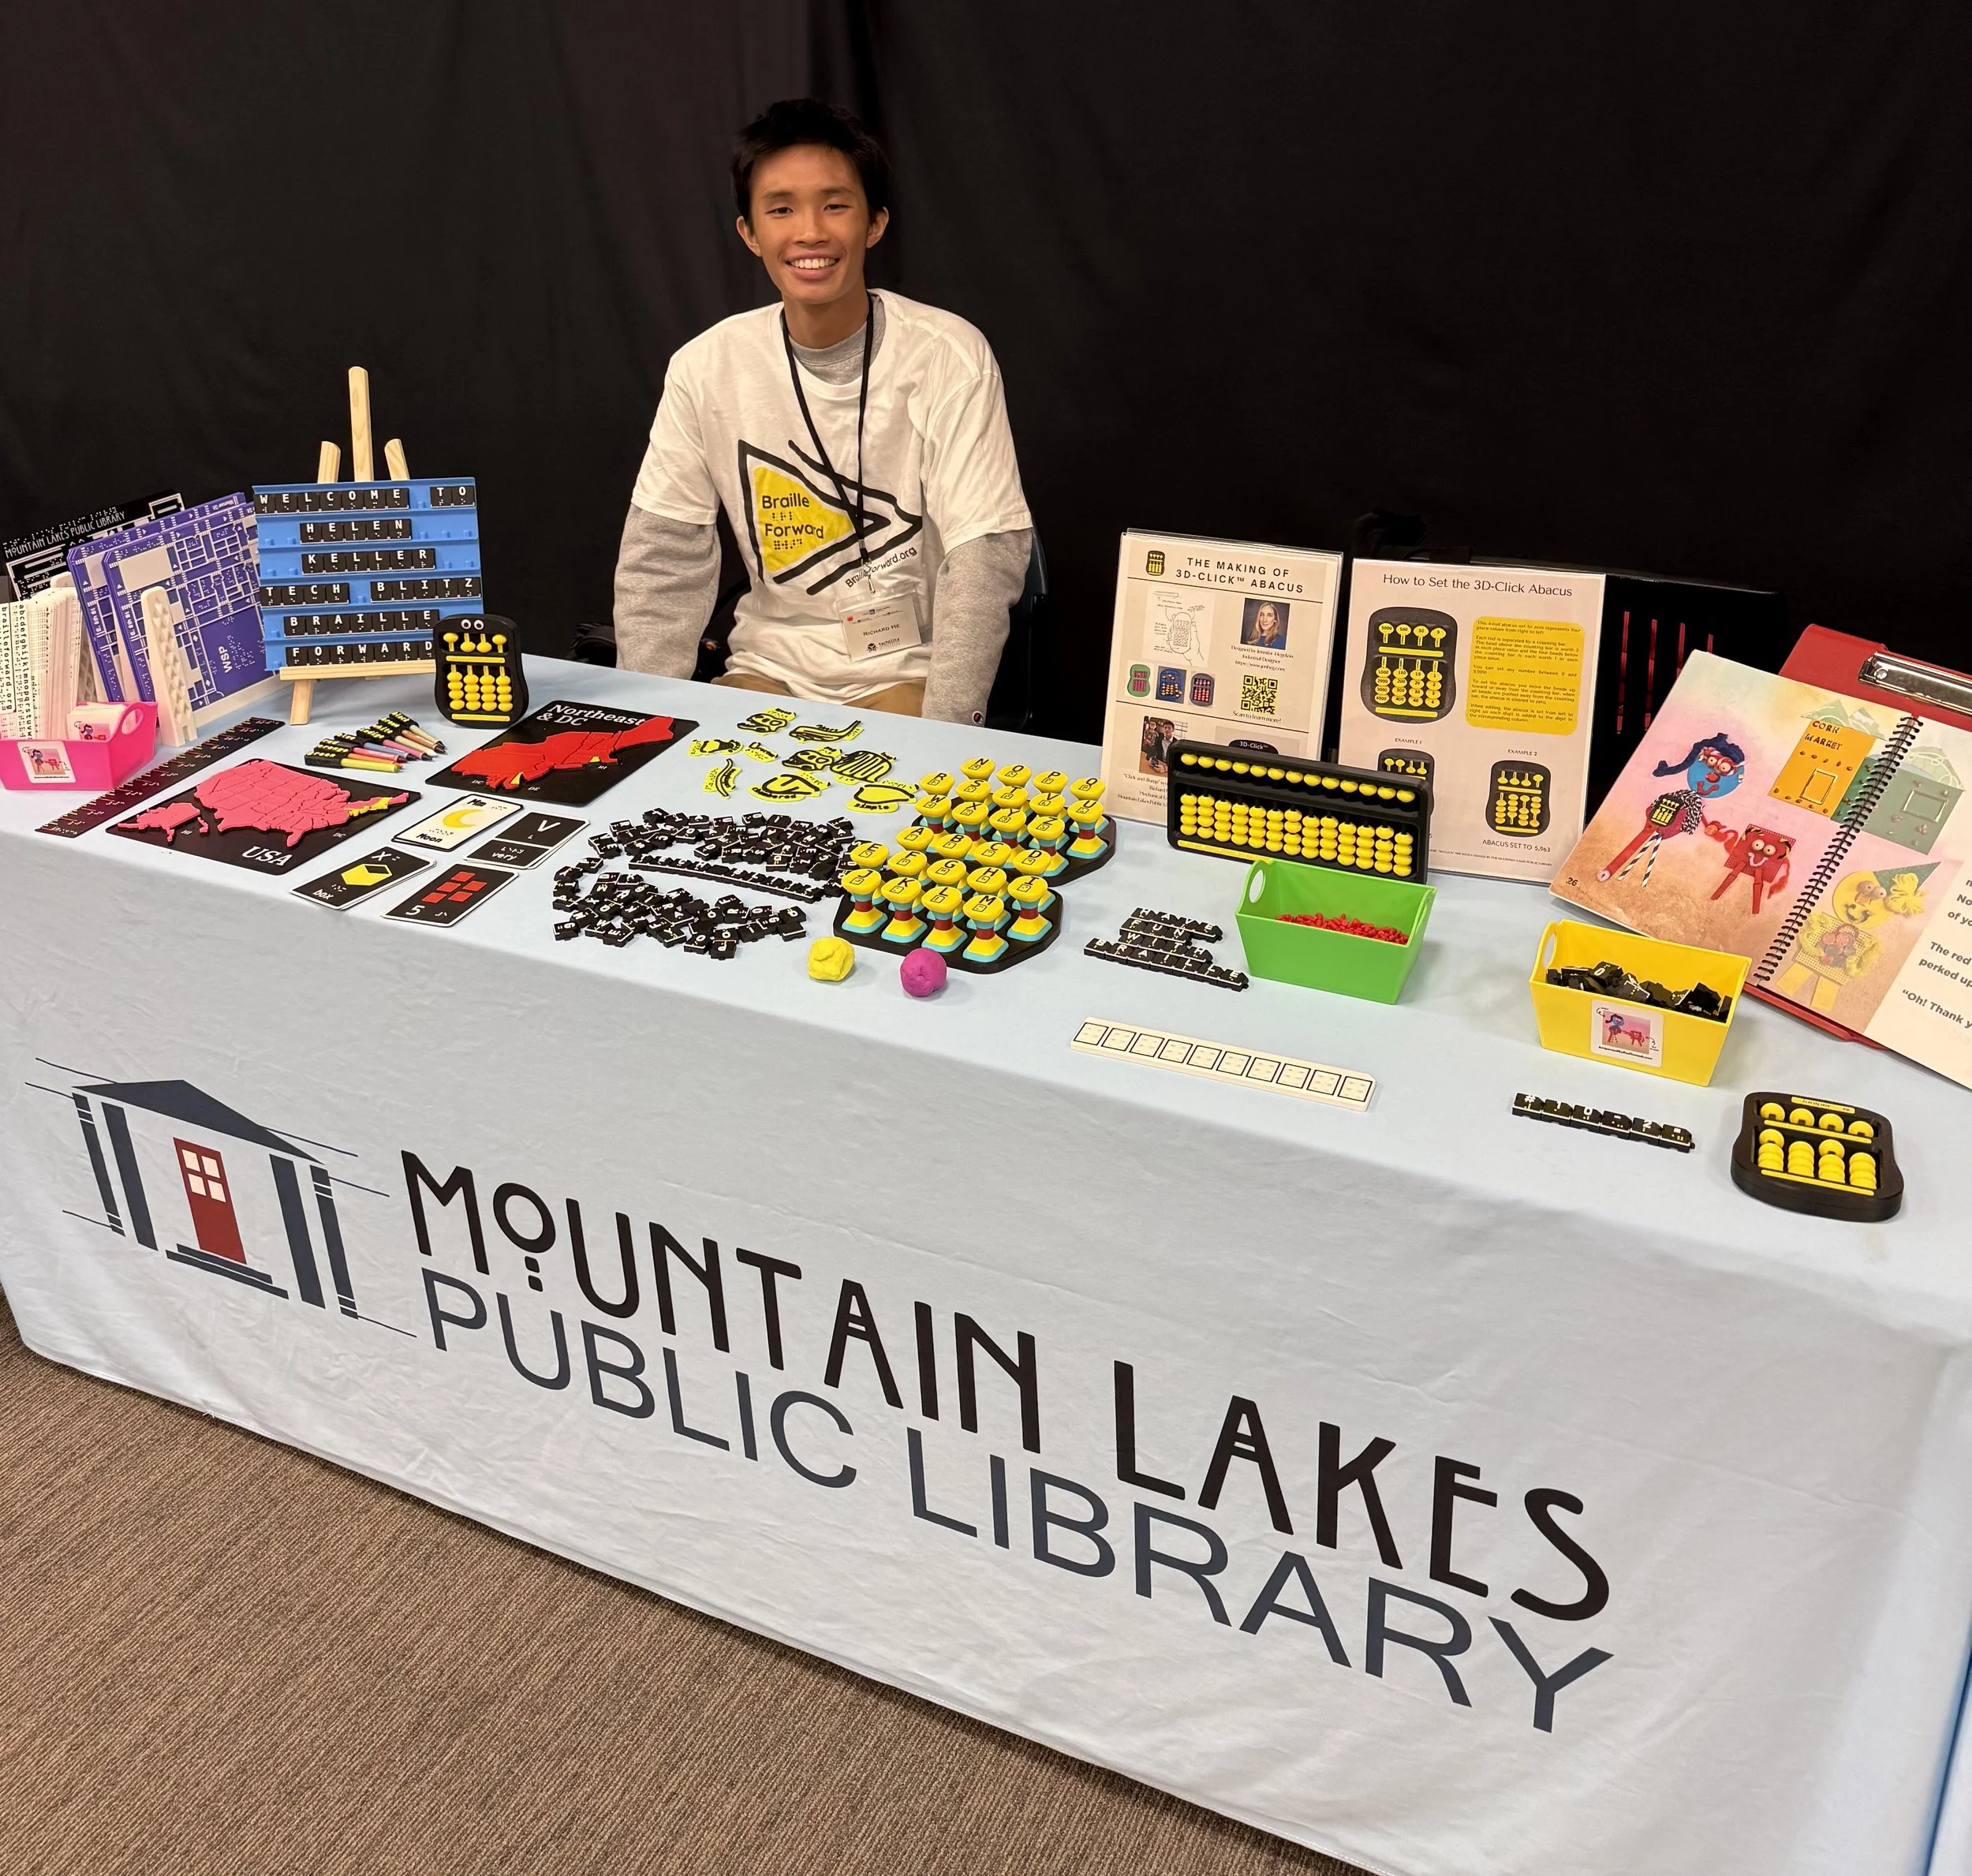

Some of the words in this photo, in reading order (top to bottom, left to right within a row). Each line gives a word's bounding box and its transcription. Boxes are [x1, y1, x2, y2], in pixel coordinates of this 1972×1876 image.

[260, 488, 401, 504] WELCOME
[436, 487, 466, 497] TO
[762, 492, 810, 509] Braille
[5, 538, 45, 558] MOUNTAIN
[47, 531, 69, 545] LAKES
[70, 521, 95, 536] PUBLIC
[95, 511, 125, 528] LIBRARY
[307, 520, 402, 533] HELEN
[764, 523, 824, 539] Forward
[308, 550, 427, 563] KELLER
[1188, 558, 1210, 568] THE
[1216, 561, 1266, 575] MAKING
[1273, 568, 1290, 577] OF
[266, 585, 340, 596] TECH
[378, 578, 472, 592] BLITZ
[1251, 579, 1303, 593] ABACUS
[1384, 574, 1410, 585] How
[1414, 576, 1425, 587] to
[1429, 577, 1448, 589] Set
[1452, 578, 1470, 590] the
[1474, 580, 1525, 593] 3D-Click
[1528, 584, 1573, 596] Abacus
[290, 611, 431, 626] BRAILLE
[863, 627, 890, 636] RICHARD
[293, 641, 432, 657] FORWARD
[2, 607, 13, 710] brailleforward.org
[217, 645, 233, 673] WSP
[547, 704, 646, 726] Northeast
[557, 716, 588, 726] DC
[1813, 720, 1839, 734] CORN
[1805, 734, 1843, 750] MARKET
[470, 798, 486, 807] Mm
[416, 832, 443, 843] Moon
[1483, 839, 1509, 848] ABACUS
[241, 846, 293, 866] USA
[491, 850, 516, 861] very
[984, 868, 998, 876] H
[1025, 876, 1036, 886] I
[1566, 876, 1578, 888] 26
[312, 890, 334, 901] box
[899, 878, 914, 887] K
[939, 888, 948, 896] L
[980, 895, 996, 905] M
[1957, 894, 1972, 906] No
[405, 905, 425, 916] 5
[1948, 911, 1960, 920] of
[1140, 908, 1213, 931] HAVE
[1131, 920, 1186, 937] FUN
[1127, 932, 1204, 955] WITH
[1095, 939, 1239, 978] BRAILLE
[1931, 941, 1949, 956] The
[1951, 953, 1971, 966] red
[1918, 959, 1959, 980] perked
[1930, 1002, 1964, 1024] Thank
[401, 1150, 1040, 1453] MOUNTAIN
[1115, 1361, 1609, 1620] LAKES
[422, 1268, 856, 1488] PUBLIC
[907, 1427, 1613, 1732] LIBRARY
